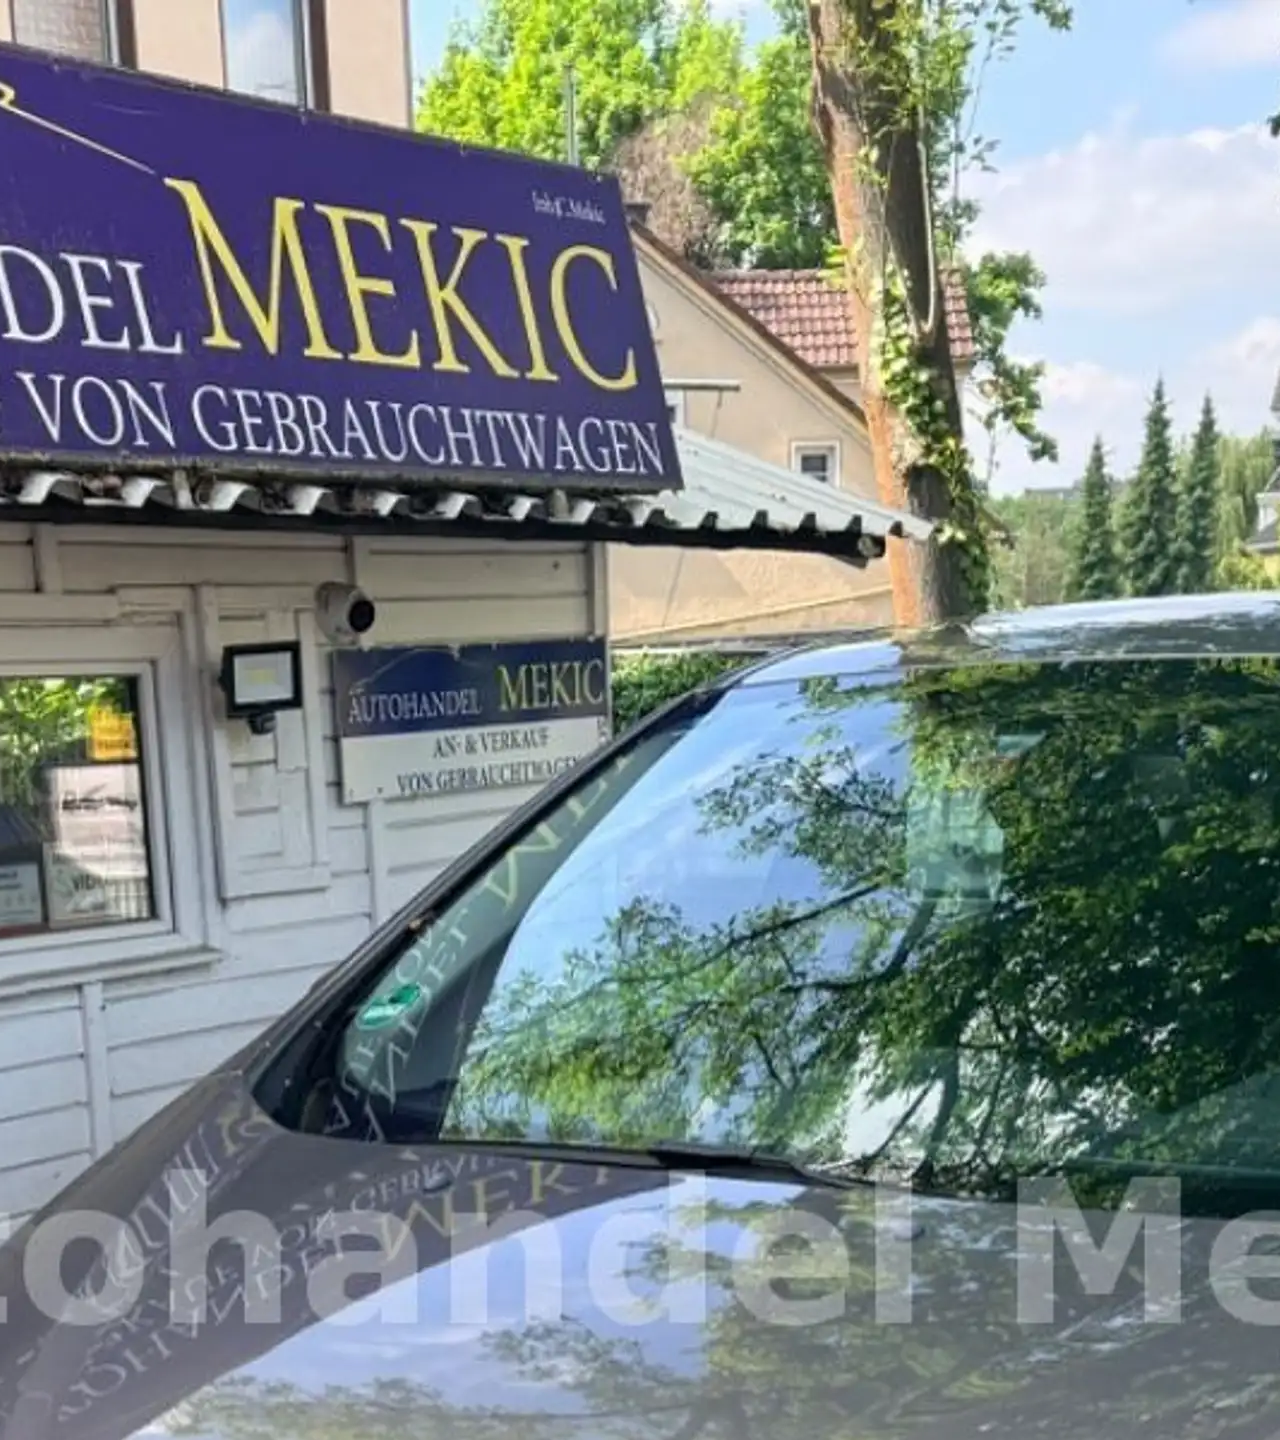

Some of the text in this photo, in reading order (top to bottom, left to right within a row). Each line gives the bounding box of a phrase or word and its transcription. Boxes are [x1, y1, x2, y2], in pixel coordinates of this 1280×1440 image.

[163, 177, 637, 392] MEKIC
[18, 371, 180, 447] VON
[192, 384, 665, 476] GEBRAUCHTWAGEN
[348, 659, 604, 724] AUTOHANDEL MEKIC
[479, 727, 549, 752] VERKAUF
[397, 769, 433, 796] VON
